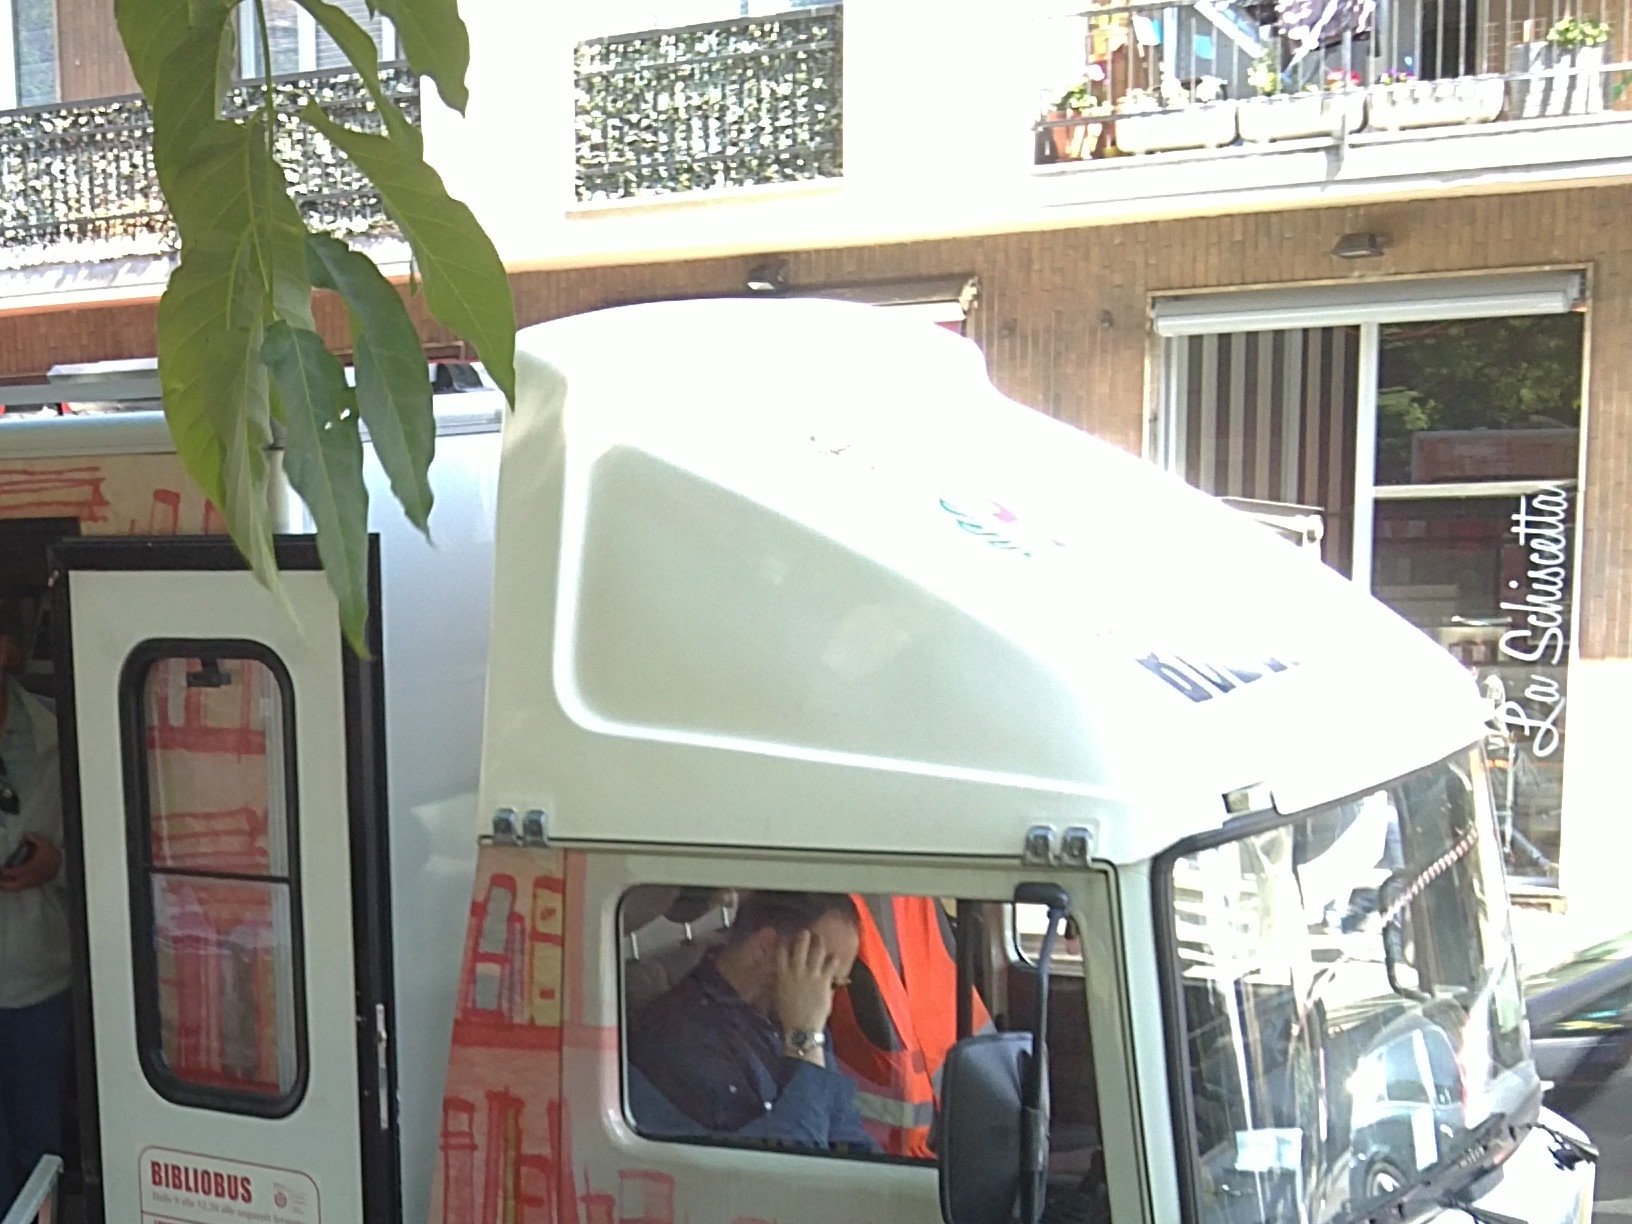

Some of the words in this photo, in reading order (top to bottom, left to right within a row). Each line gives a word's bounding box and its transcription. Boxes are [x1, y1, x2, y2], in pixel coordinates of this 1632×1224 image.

[1499, 485, 1568, 665] Schiscetta
[1495, 674, 1565, 757] La
[151, 1160, 252, 1204] BIBLIOBUS
